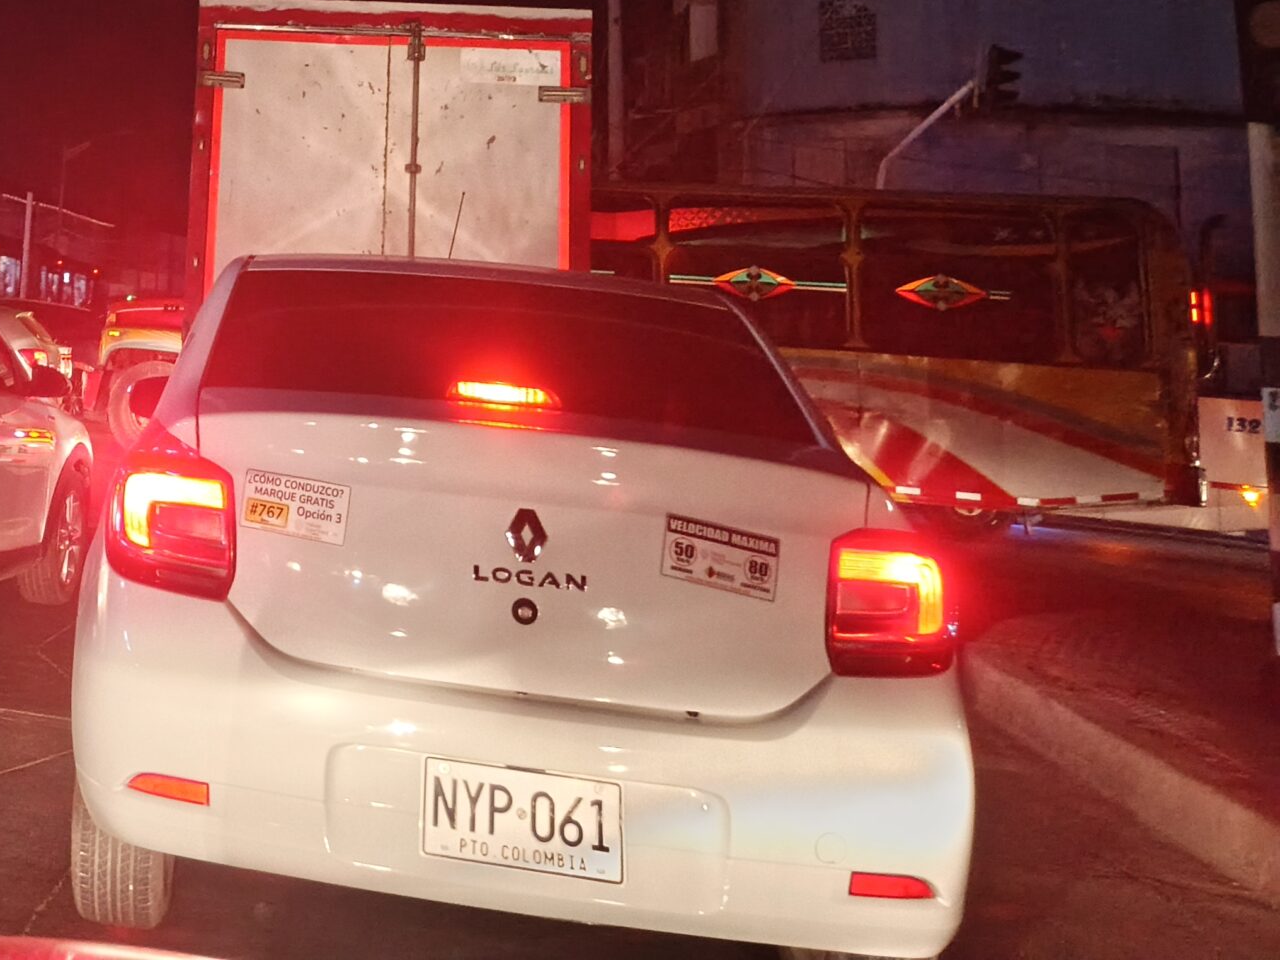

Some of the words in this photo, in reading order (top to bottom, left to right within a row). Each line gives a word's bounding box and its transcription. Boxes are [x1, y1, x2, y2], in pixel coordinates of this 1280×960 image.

[248, 473, 282, 490] ¿CÓMO
[284, 479, 345, 498] CONDUZCO?
[254, 487, 297, 502] MARQUE
[299, 495, 335, 509] GRATIS
[250, 503, 284, 520] #767
[297, 506, 333, 523] Opción
[335, 513, 343, 524] 3
[669, 518, 730, 542] VELOCIDAD
[674, 541, 695, 559] 50
[473, 564, 588, 592] LOGAN
[748, 560, 769, 577] 80
[432, 776, 513, 835] NYP
[531, 791, 610, 853] 061
[459, 838, 489, 856] PTO
[501, 845, 587, 871] COLOMBIA
